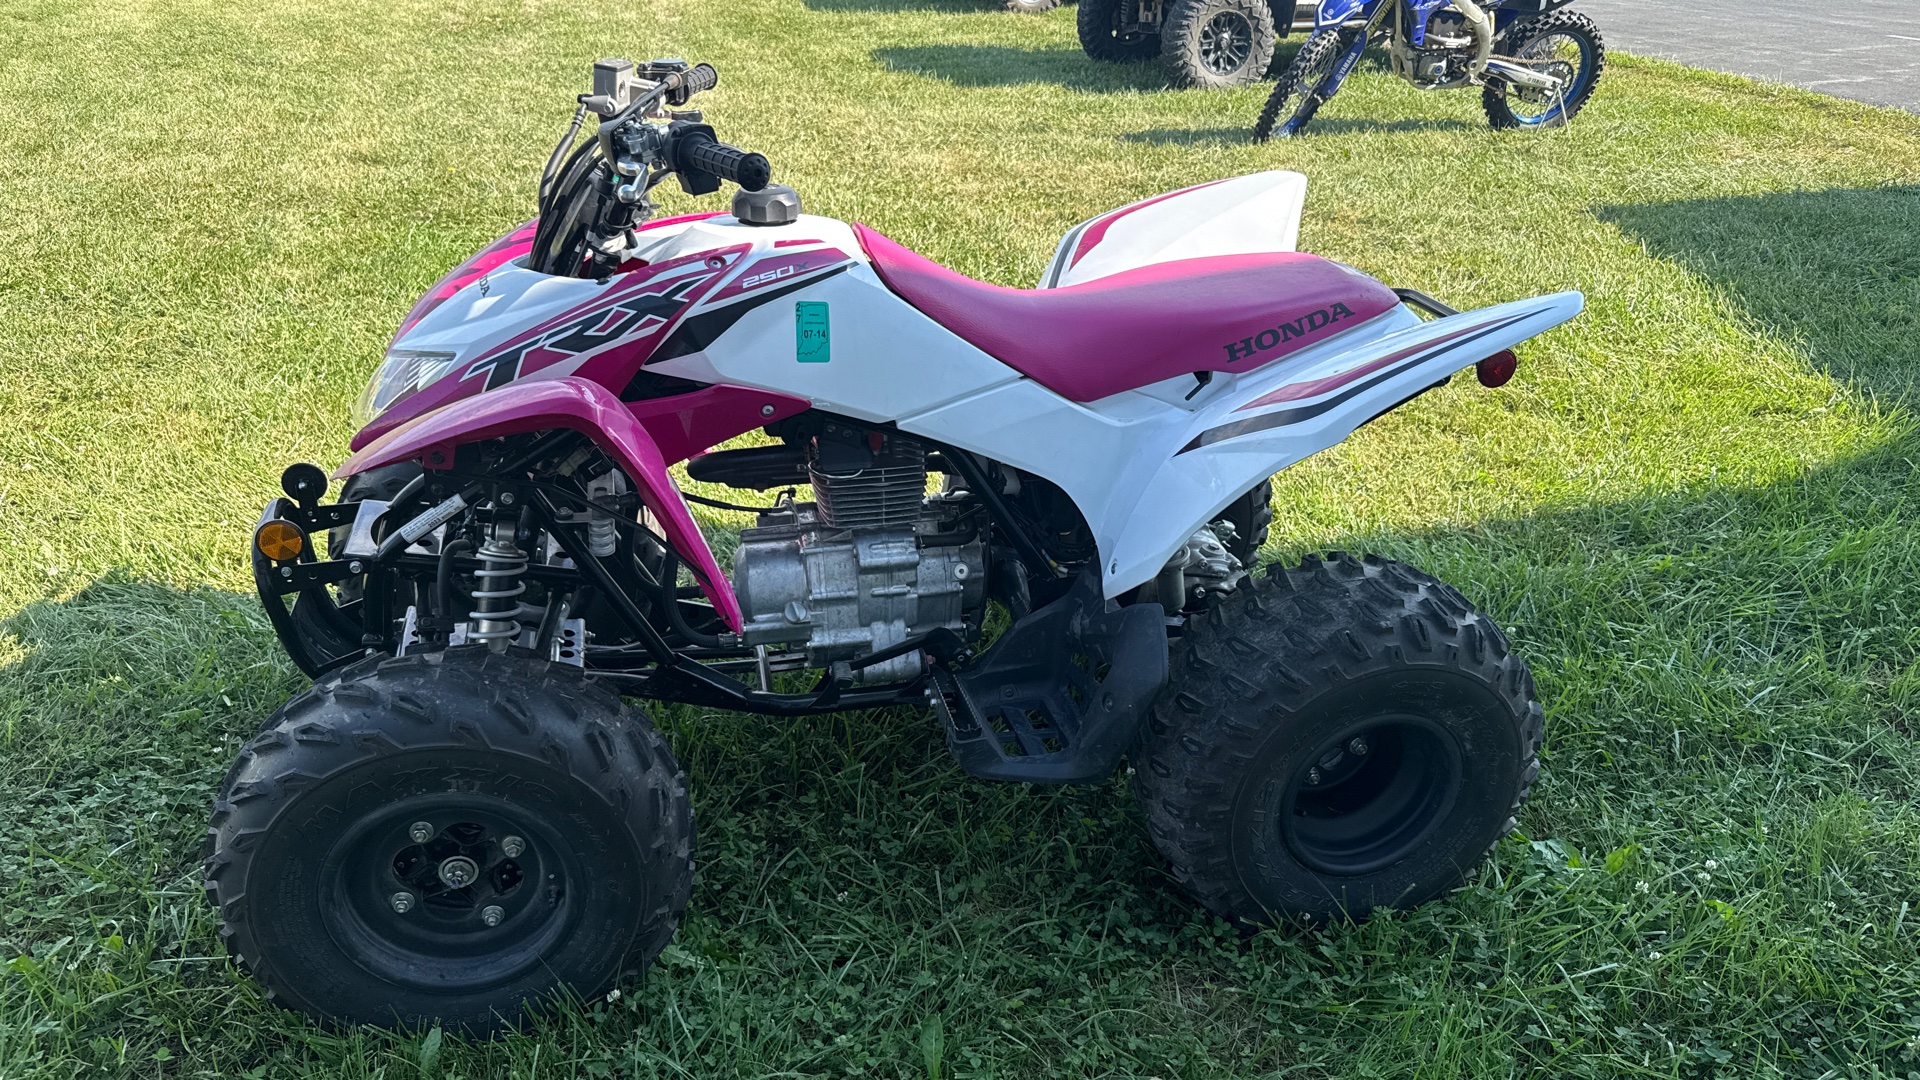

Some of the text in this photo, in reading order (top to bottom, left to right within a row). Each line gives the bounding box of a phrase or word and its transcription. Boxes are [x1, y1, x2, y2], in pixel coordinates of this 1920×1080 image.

[1339, 52, 1357, 75] YAMAHA
[459, 271, 720, 392] TRX
[803, 329, 827, 339] 07-14
[1223, 302, 1355, 363] HONDA
